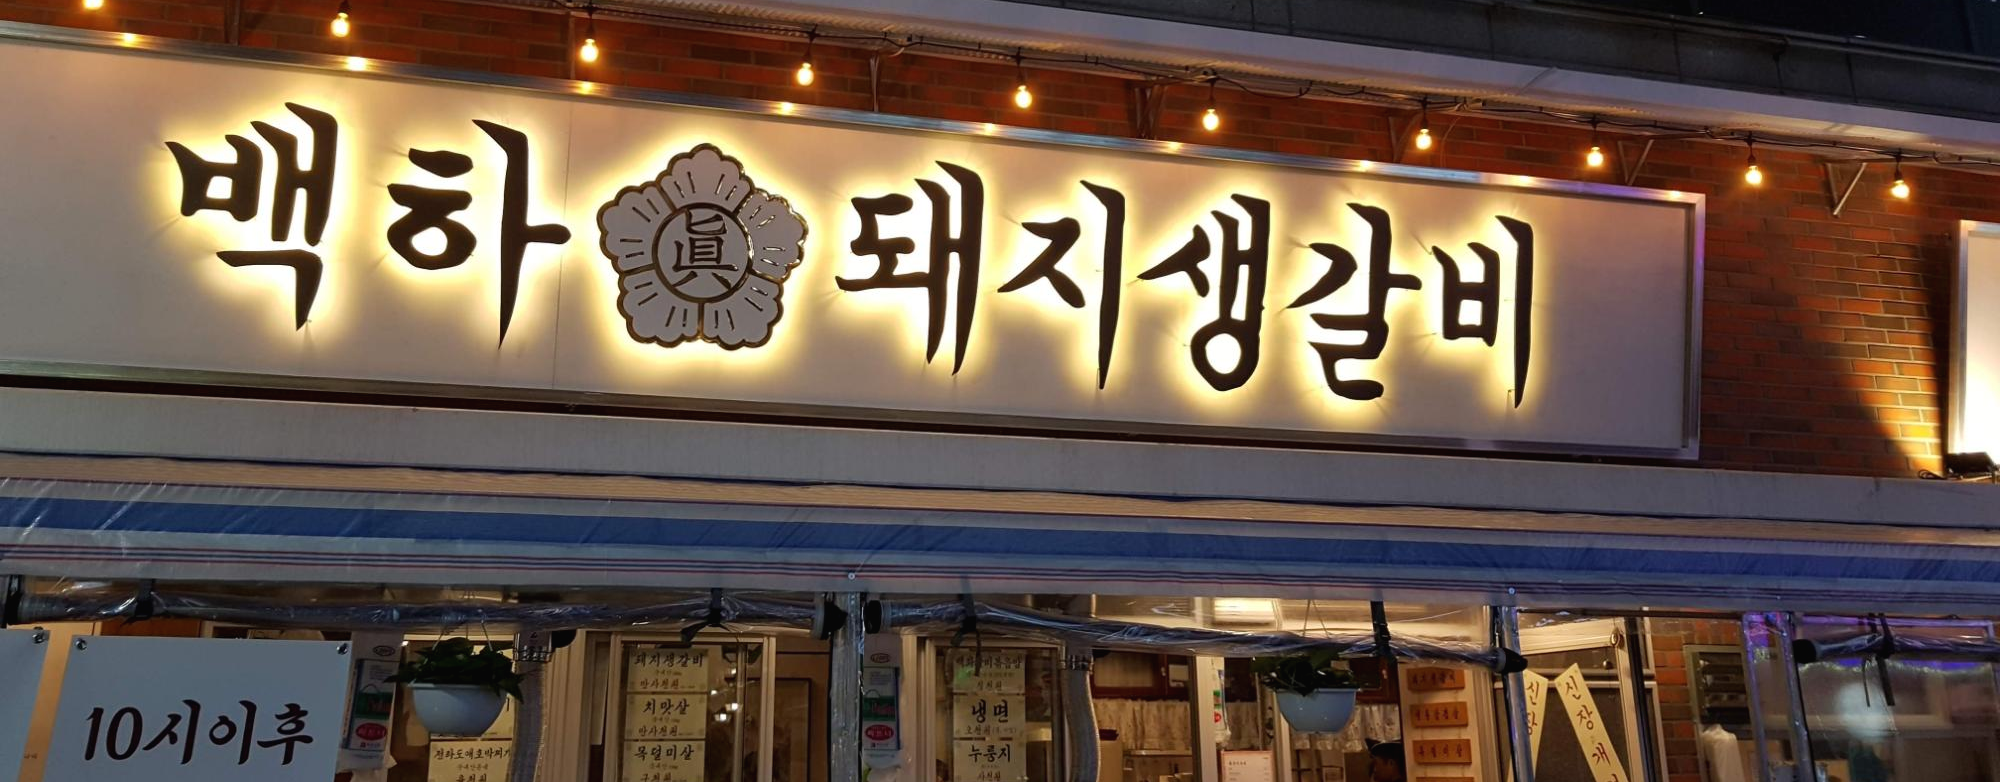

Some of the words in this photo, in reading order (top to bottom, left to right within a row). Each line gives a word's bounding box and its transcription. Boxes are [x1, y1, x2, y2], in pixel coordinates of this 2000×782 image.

[166, 102, 571, 348] 백하
[835, 160, 1533, 408] 돼지생갈비
[634, 652, 703, 668] 돼지생갈비
[972, 699, 1008, 723] 냉면
[968, 744, 1011, 763] 누룽지
